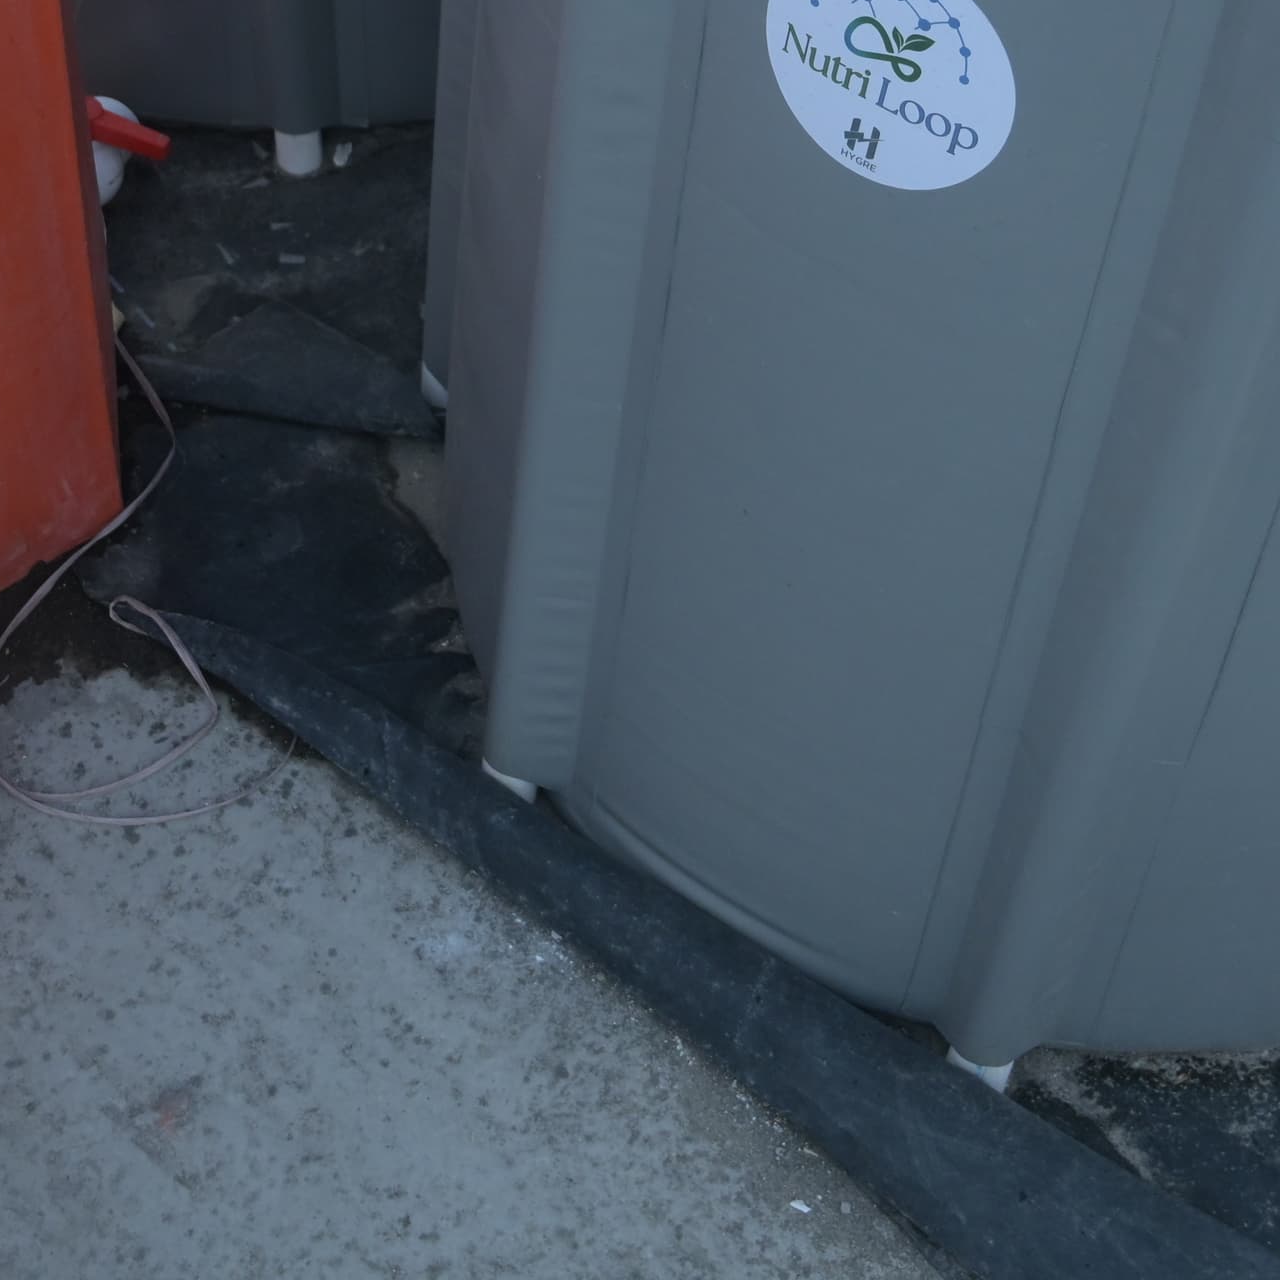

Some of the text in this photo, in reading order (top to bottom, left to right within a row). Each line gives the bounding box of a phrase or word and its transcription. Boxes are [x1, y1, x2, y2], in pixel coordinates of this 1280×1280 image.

[782, 22, 980, 155] Nutri Loop
[840, 148, 878, 173] HYGRE
